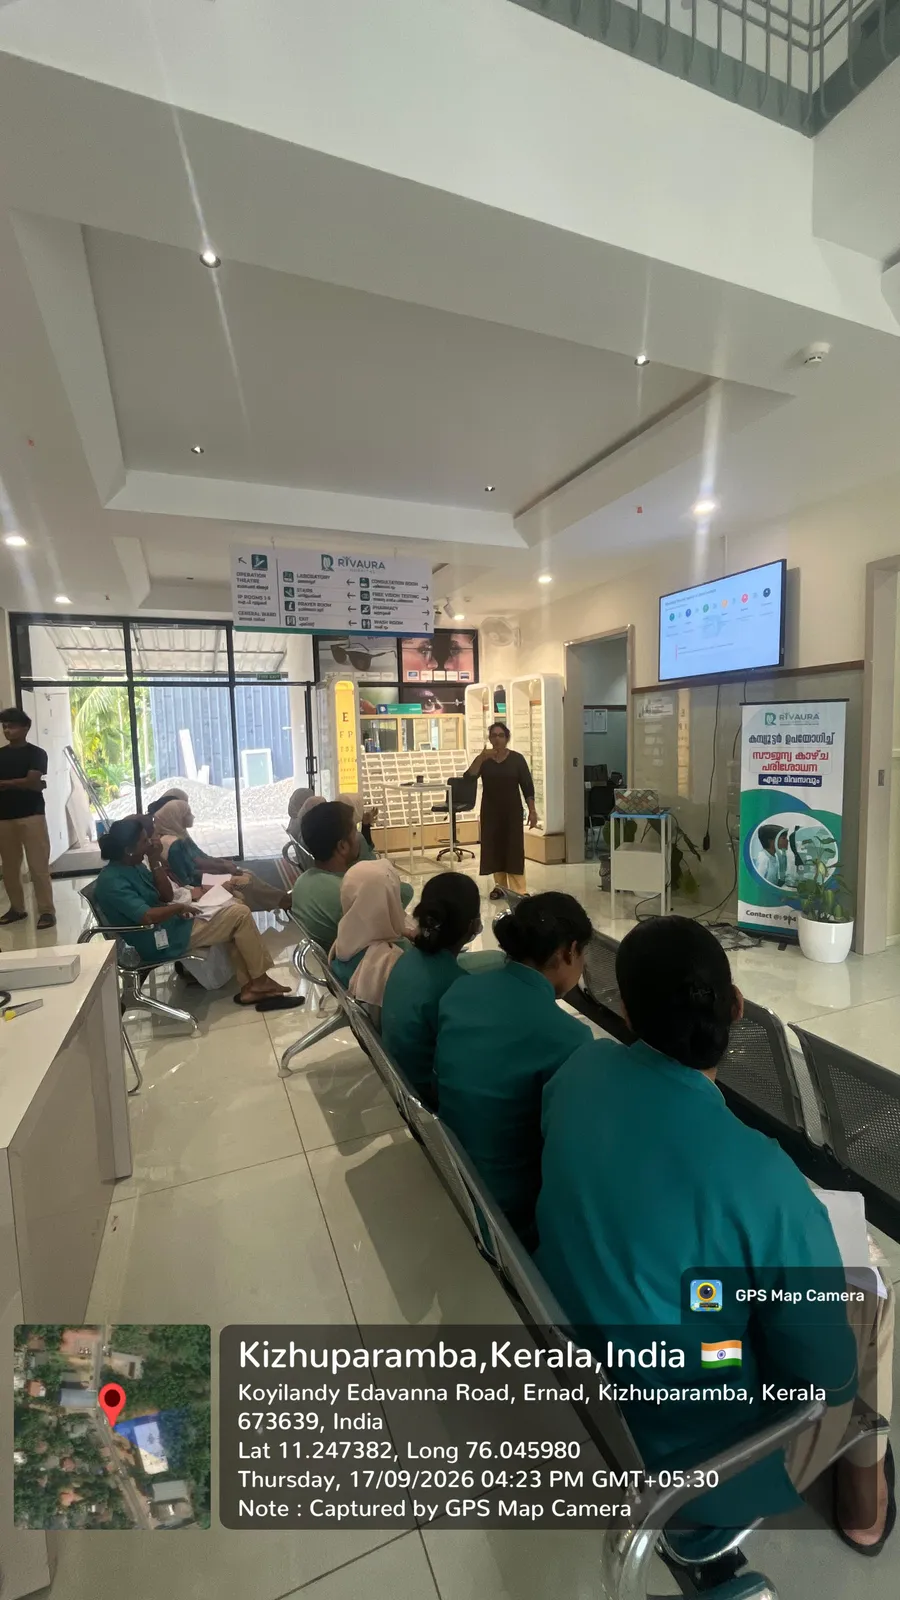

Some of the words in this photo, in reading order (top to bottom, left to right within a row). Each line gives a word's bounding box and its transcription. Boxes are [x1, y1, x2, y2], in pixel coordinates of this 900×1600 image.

[337, 557, 385, 570] RIVAURA
[342, 712, 349, 722] E
[779, 712, 820, 720] RIVAURA
[762, 761, 818, 772] പരിശോധന
[746, 910, 772, 918] Contact
